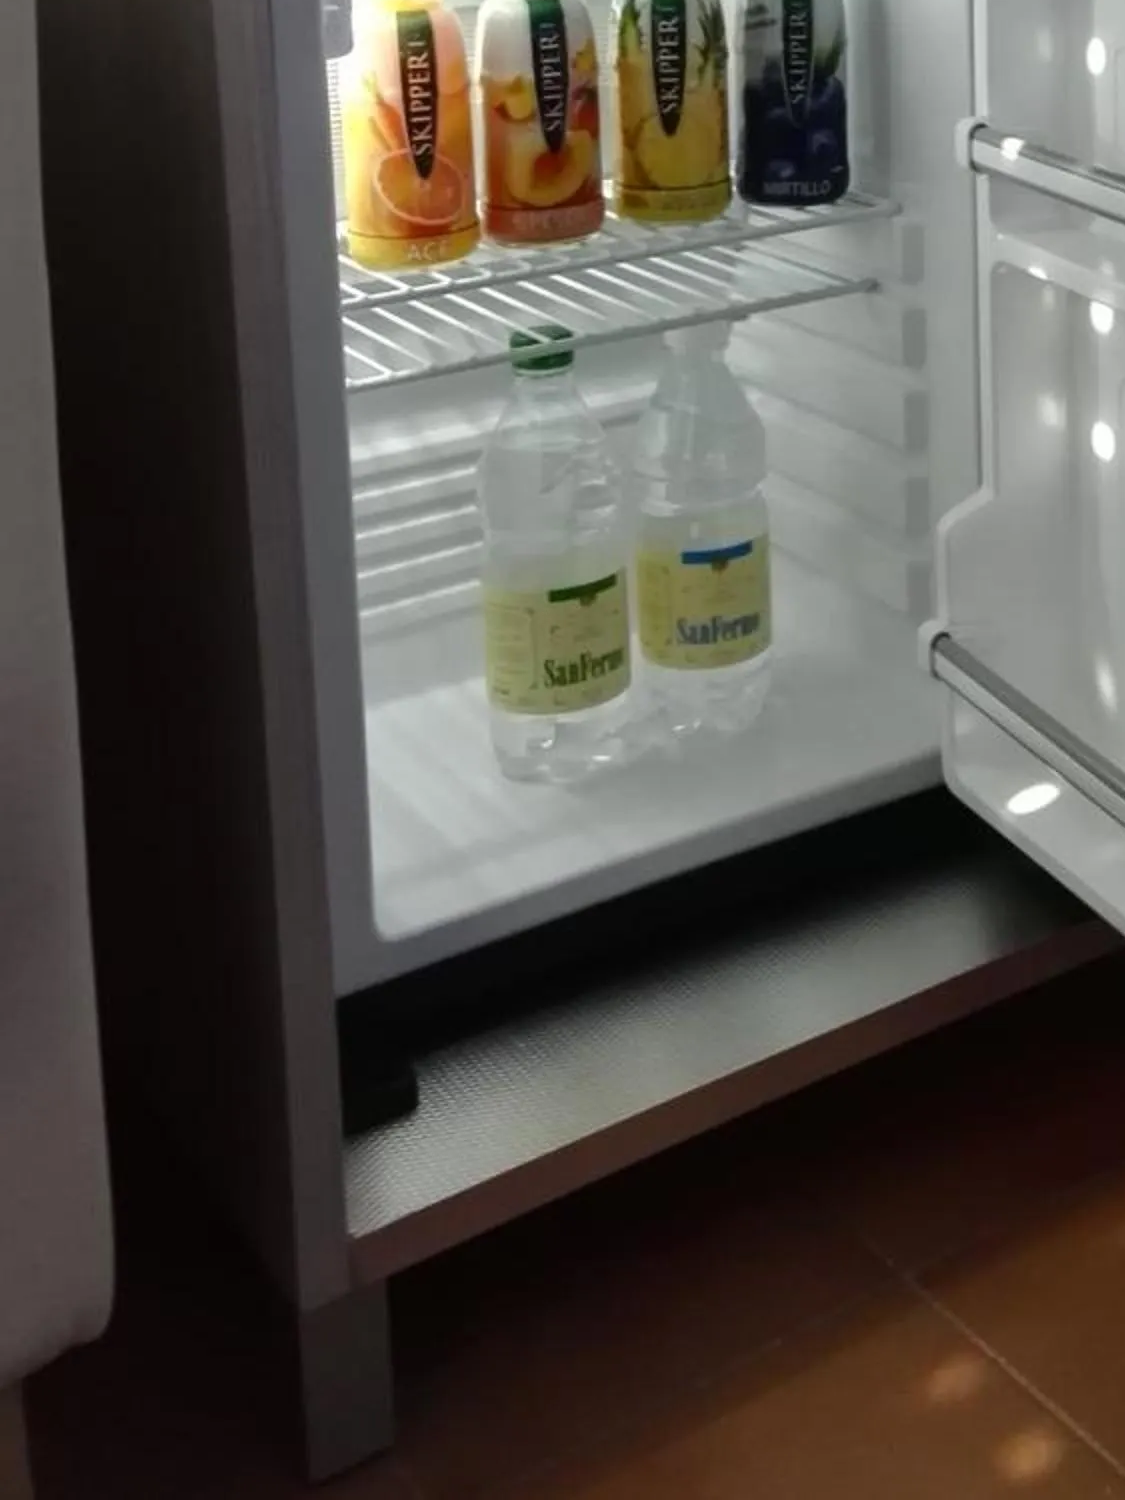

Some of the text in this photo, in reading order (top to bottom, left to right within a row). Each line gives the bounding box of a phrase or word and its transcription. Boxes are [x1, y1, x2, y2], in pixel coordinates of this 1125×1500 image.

[407, 50, 433, 157] SKIPPER
[539, 31, 565, 132] SKIPPER
[658, 15, 681, 114] SKIPPER
